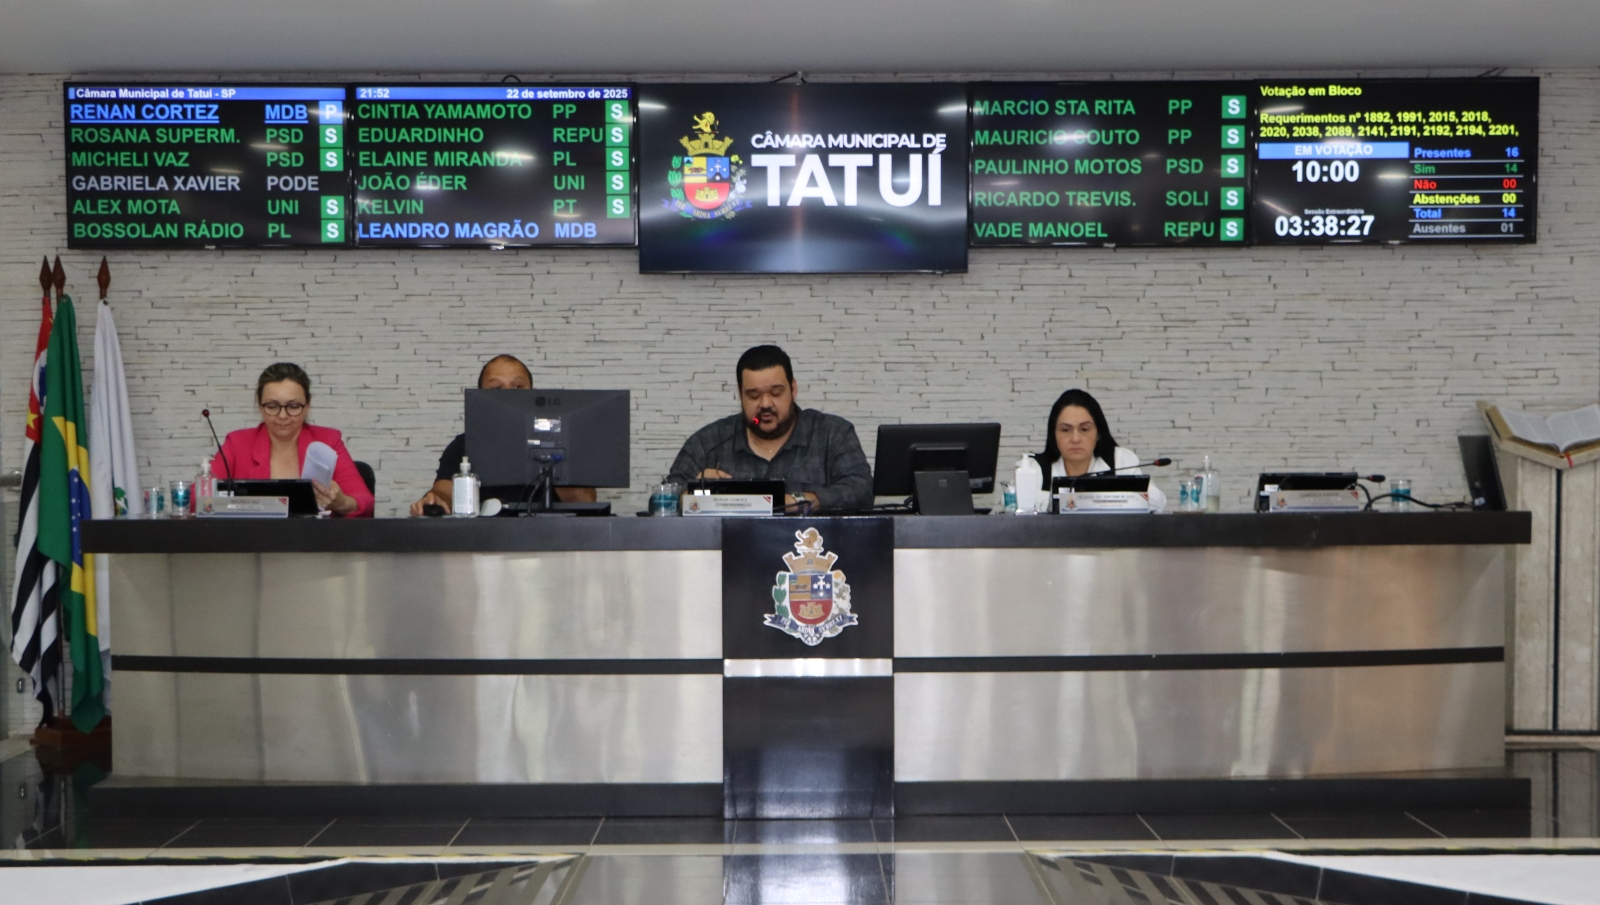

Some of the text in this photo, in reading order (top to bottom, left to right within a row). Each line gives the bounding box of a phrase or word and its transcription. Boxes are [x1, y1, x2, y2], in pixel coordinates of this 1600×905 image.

[76, 88, 116, 99] Câmara
[119, 88, 169, 100] Municipal
[172, 89, 184, 99] de
[221, 89, 236, 99] SP
[360, 89, 390, 98] 21:52
[506, 89, 628, 99] 22 de setembro de 2025
[1260, 85, 1361, 98] Votação em Bloco
[70, 104, 337, 119] RENAN CORTEZ MDB P
[358, 104, 623, 119] CINTIA YAMAMOTO PP S
[974, 99, 1240, 115] MARCIO STA RITA PP S
[1260, 113, 1345, 124] Requerimentos
[1365, 112, 1393, 124] 1892,
[1397, 112, 1425, 123] 1991,
[1429, 112, 1458, 123] 2015,
[1461, 112, 1491, 123] 2018,
[71, 128, 337, 143] ROSANA SUPERM. PSD S
[358, 128, 623, 143] EDUARDINHO REPU S
[974, 129, 1239, 145] MAURICIO COUTO PP S
[1260, 125, 1518, 138] 2020, 2038, 2089, 2141, 2191, 2192, 2194, 2201,
[751, 131, 946, 148] CÂMARA MUNICIPAL DE
[1295, 143, 1373, 157] EM VOTAÇÃO
[1414, 147, 1519, 158] Presentes 16
[72, 151, 338, 167] MICHELI VAZ PSD S
[359, 151, 623, 166] ELAINE MIRANDA PL S
[974, 158, 1239, 174] PAULINHO MOTOS PSD S
[1292, 160, 1359, 182] 10:00
[1414, 163, 1518, 173] Sim 14
[72, 176, 319, 191] GABRIELA XAVIER PODE
[358, 172, 624, 190] JOÃO ÉDER UNI S
[751, 147, 946, 206] TATUÍ
[1414, 179, 1516, 189] Não 00
[974, 191, 1238, 206] RICARDO TREVIS. SOLI S
[1413, 193, 1516, 206] Abstenções 00
[73, 199, 338, 215] ALEX MOTA UNI S
[358, 199, 624, 214] KELVIN PT S
[1414, 207, 1516, 218] Total 14
[74, 220, 338, 239] BOSSOLAN RÁDIO PL S
[359, 219, 597, 238] LEANDRO MAGRÃO MDB
[974, 222, 1238, 237] VADE MANOEL REPU S
[1275, 215, 1374, 236] 03:38:27
[1413, 223, 1513, 233] Ausentes 01
[548, 398, 562, 406] LG
